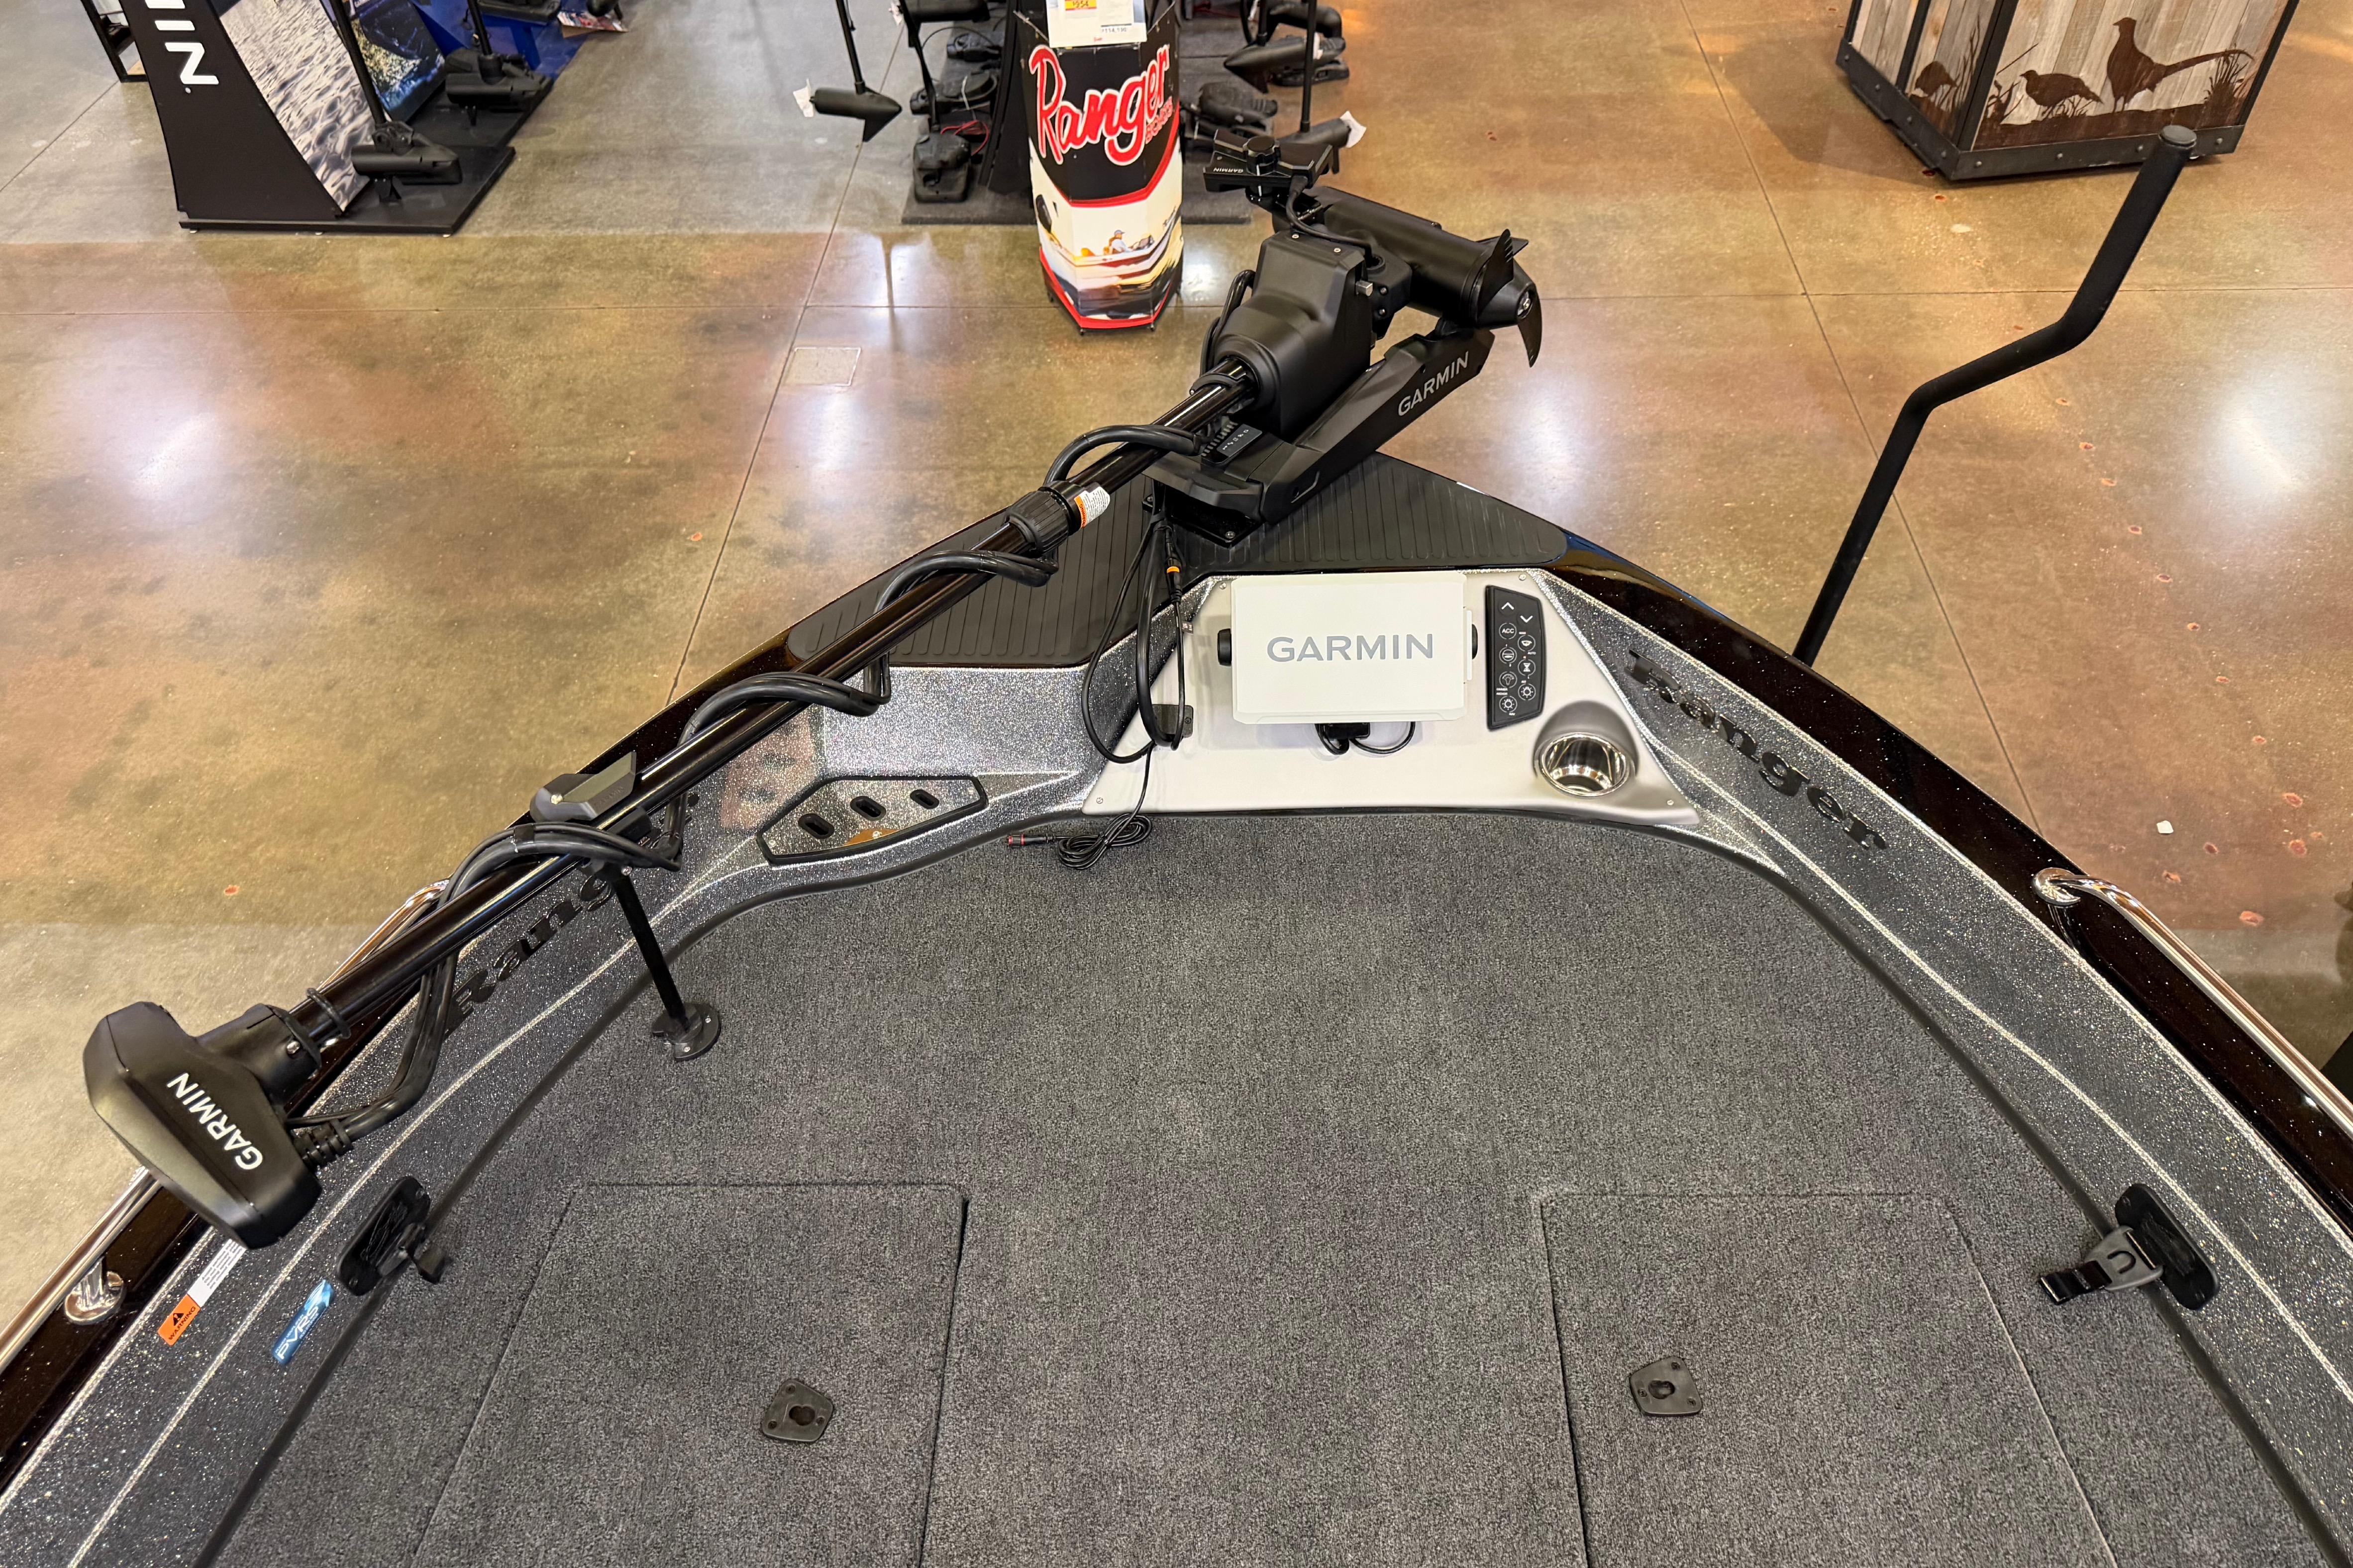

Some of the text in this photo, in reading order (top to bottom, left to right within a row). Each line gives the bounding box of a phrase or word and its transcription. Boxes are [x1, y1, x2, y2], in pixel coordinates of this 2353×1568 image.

[145, 0, 219, 84] IN
[1028, 45, 1169, 165] Ranger
[1398, 351, 1468, 416] GARMIN
[1267, 634, 1432, 662] GARMIN
[1624, 649, 1886, 849] Ranger
[444, 874, 615, 1035] Rang
[167, 1073, 263, 1170] GARMIN
[168, 1306, 196, 1340] WARNING
[275, 1338, 287, 1353] POWER
[277, 1305, 319, 1360] PVRS
